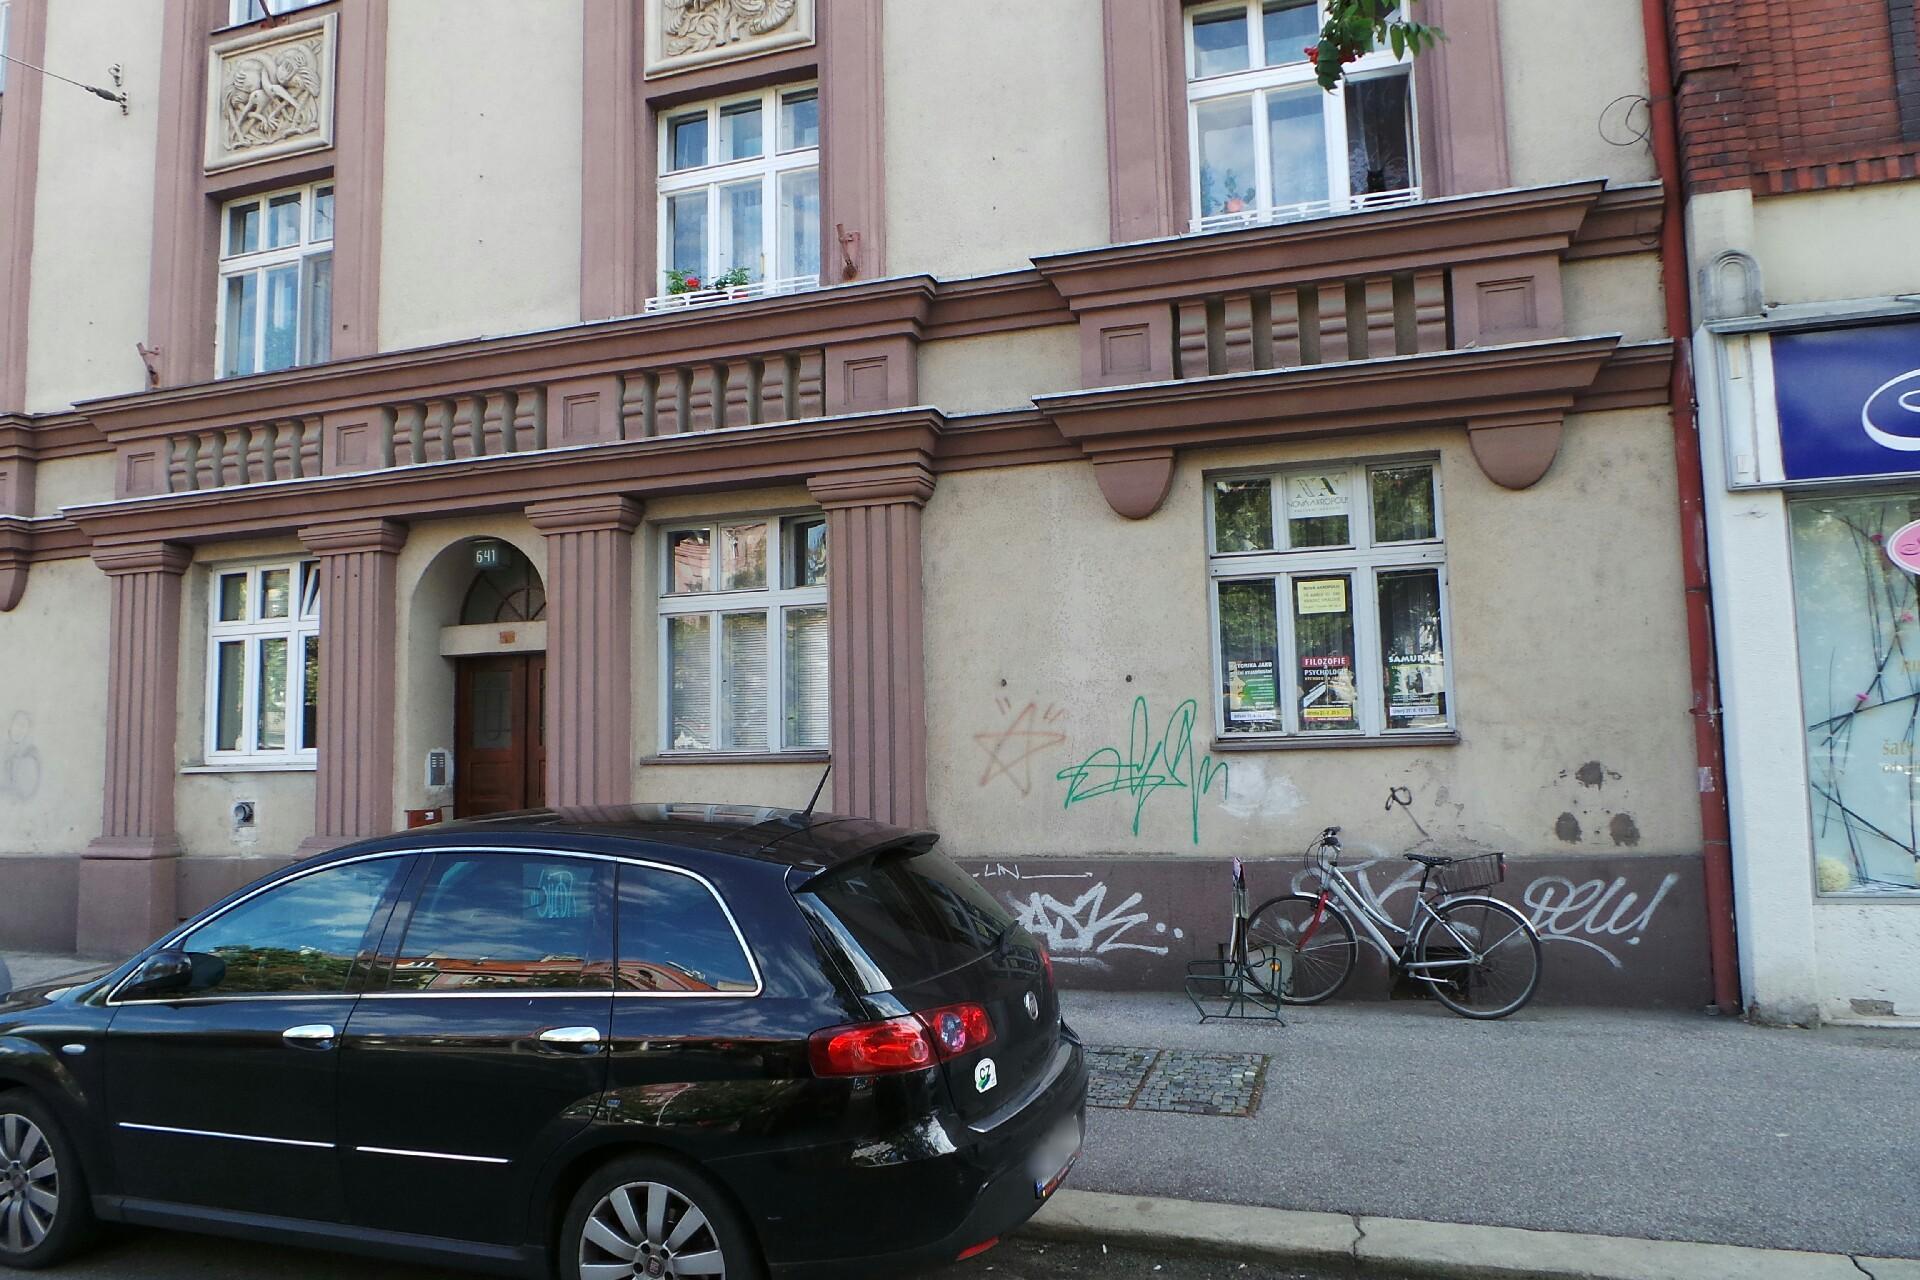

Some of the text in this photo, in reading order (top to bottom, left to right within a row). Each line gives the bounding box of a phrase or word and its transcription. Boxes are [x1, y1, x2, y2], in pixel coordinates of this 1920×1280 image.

[476, 549, 496, 563] 641
[1304, 657, 1346, 666] FILOZOFIE
[980, 1064, 991, 1081] CZ
